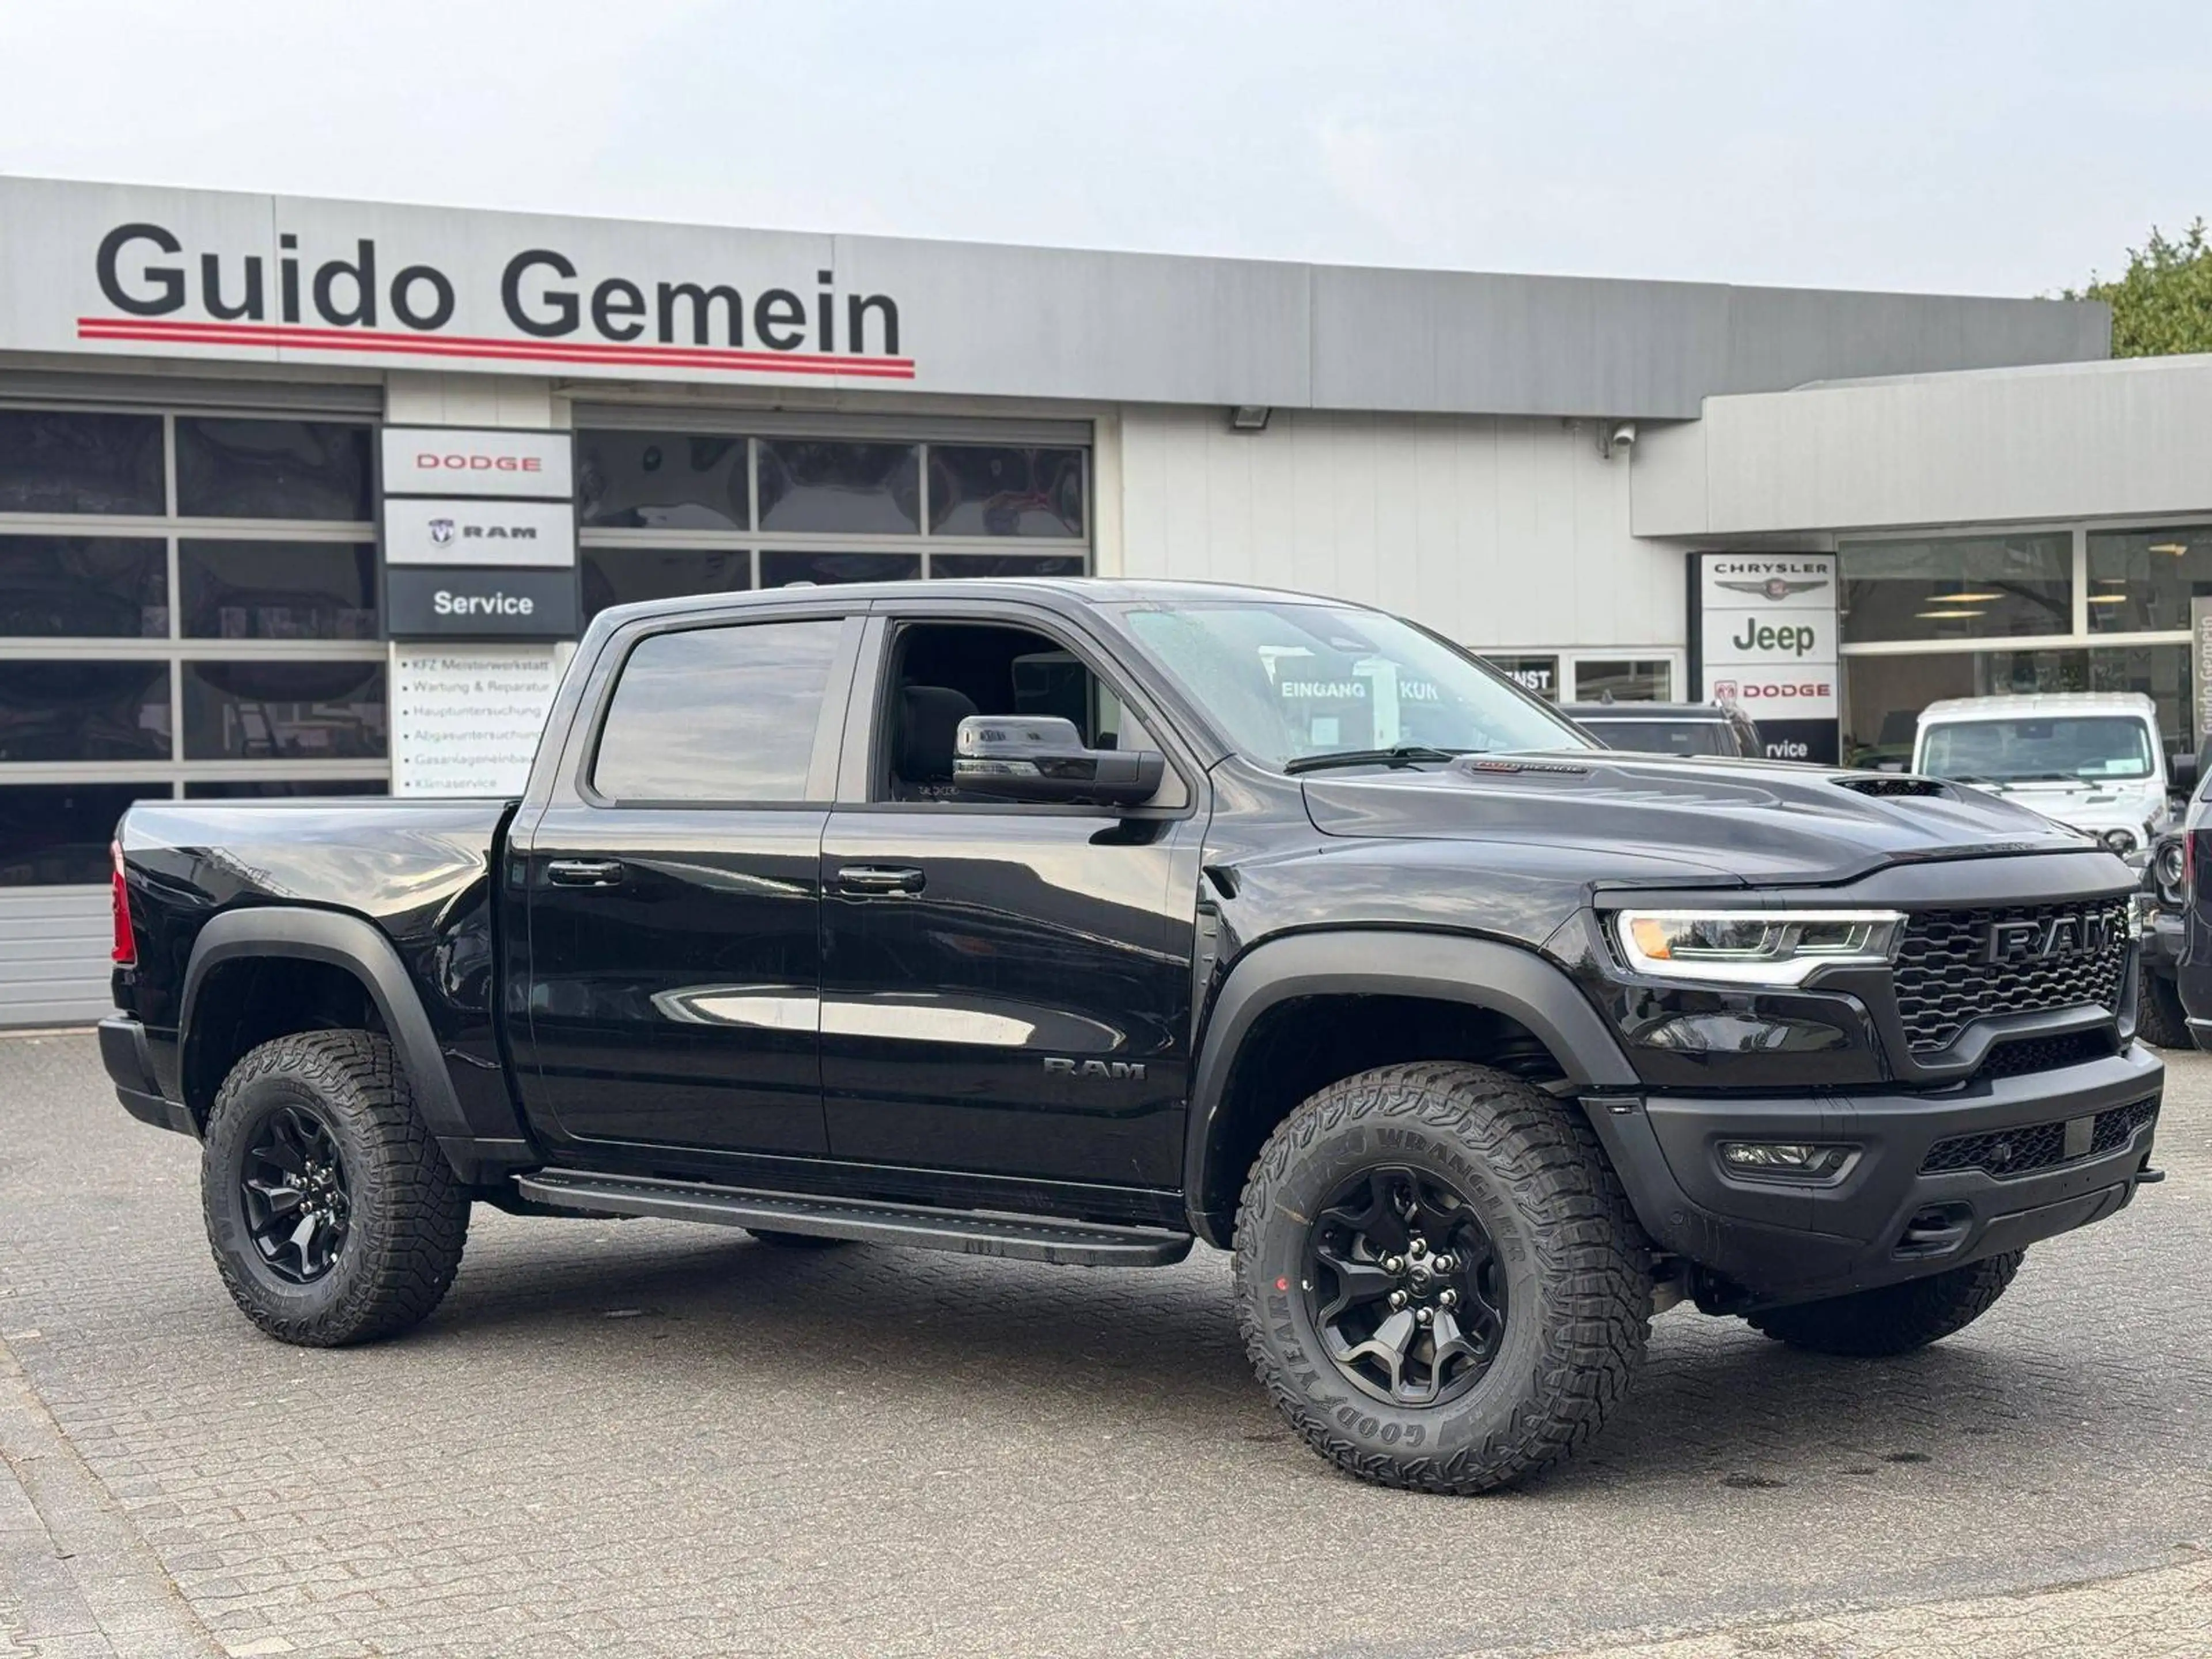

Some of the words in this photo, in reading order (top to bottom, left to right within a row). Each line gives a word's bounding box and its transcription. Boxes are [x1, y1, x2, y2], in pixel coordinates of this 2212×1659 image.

[96, 222, 455, 331] Guido
[501, 248, 899, 355] Gemein
[417, 454, 541, 472] DODGE
[463, 525, 537, 540] RAM
[1714, 563, 1827, 573] CHRYSLER
[434, 591, 534, 615] Service
[1733, 618, 1815, 656] Jeep
[1282, 681, 1365, 698] EINGANG
[1744, 684, 1830, 698] DODGE
[1990, 912, 2118, 963] RAM
[1044, 1058, 1148, 1081] RAM
